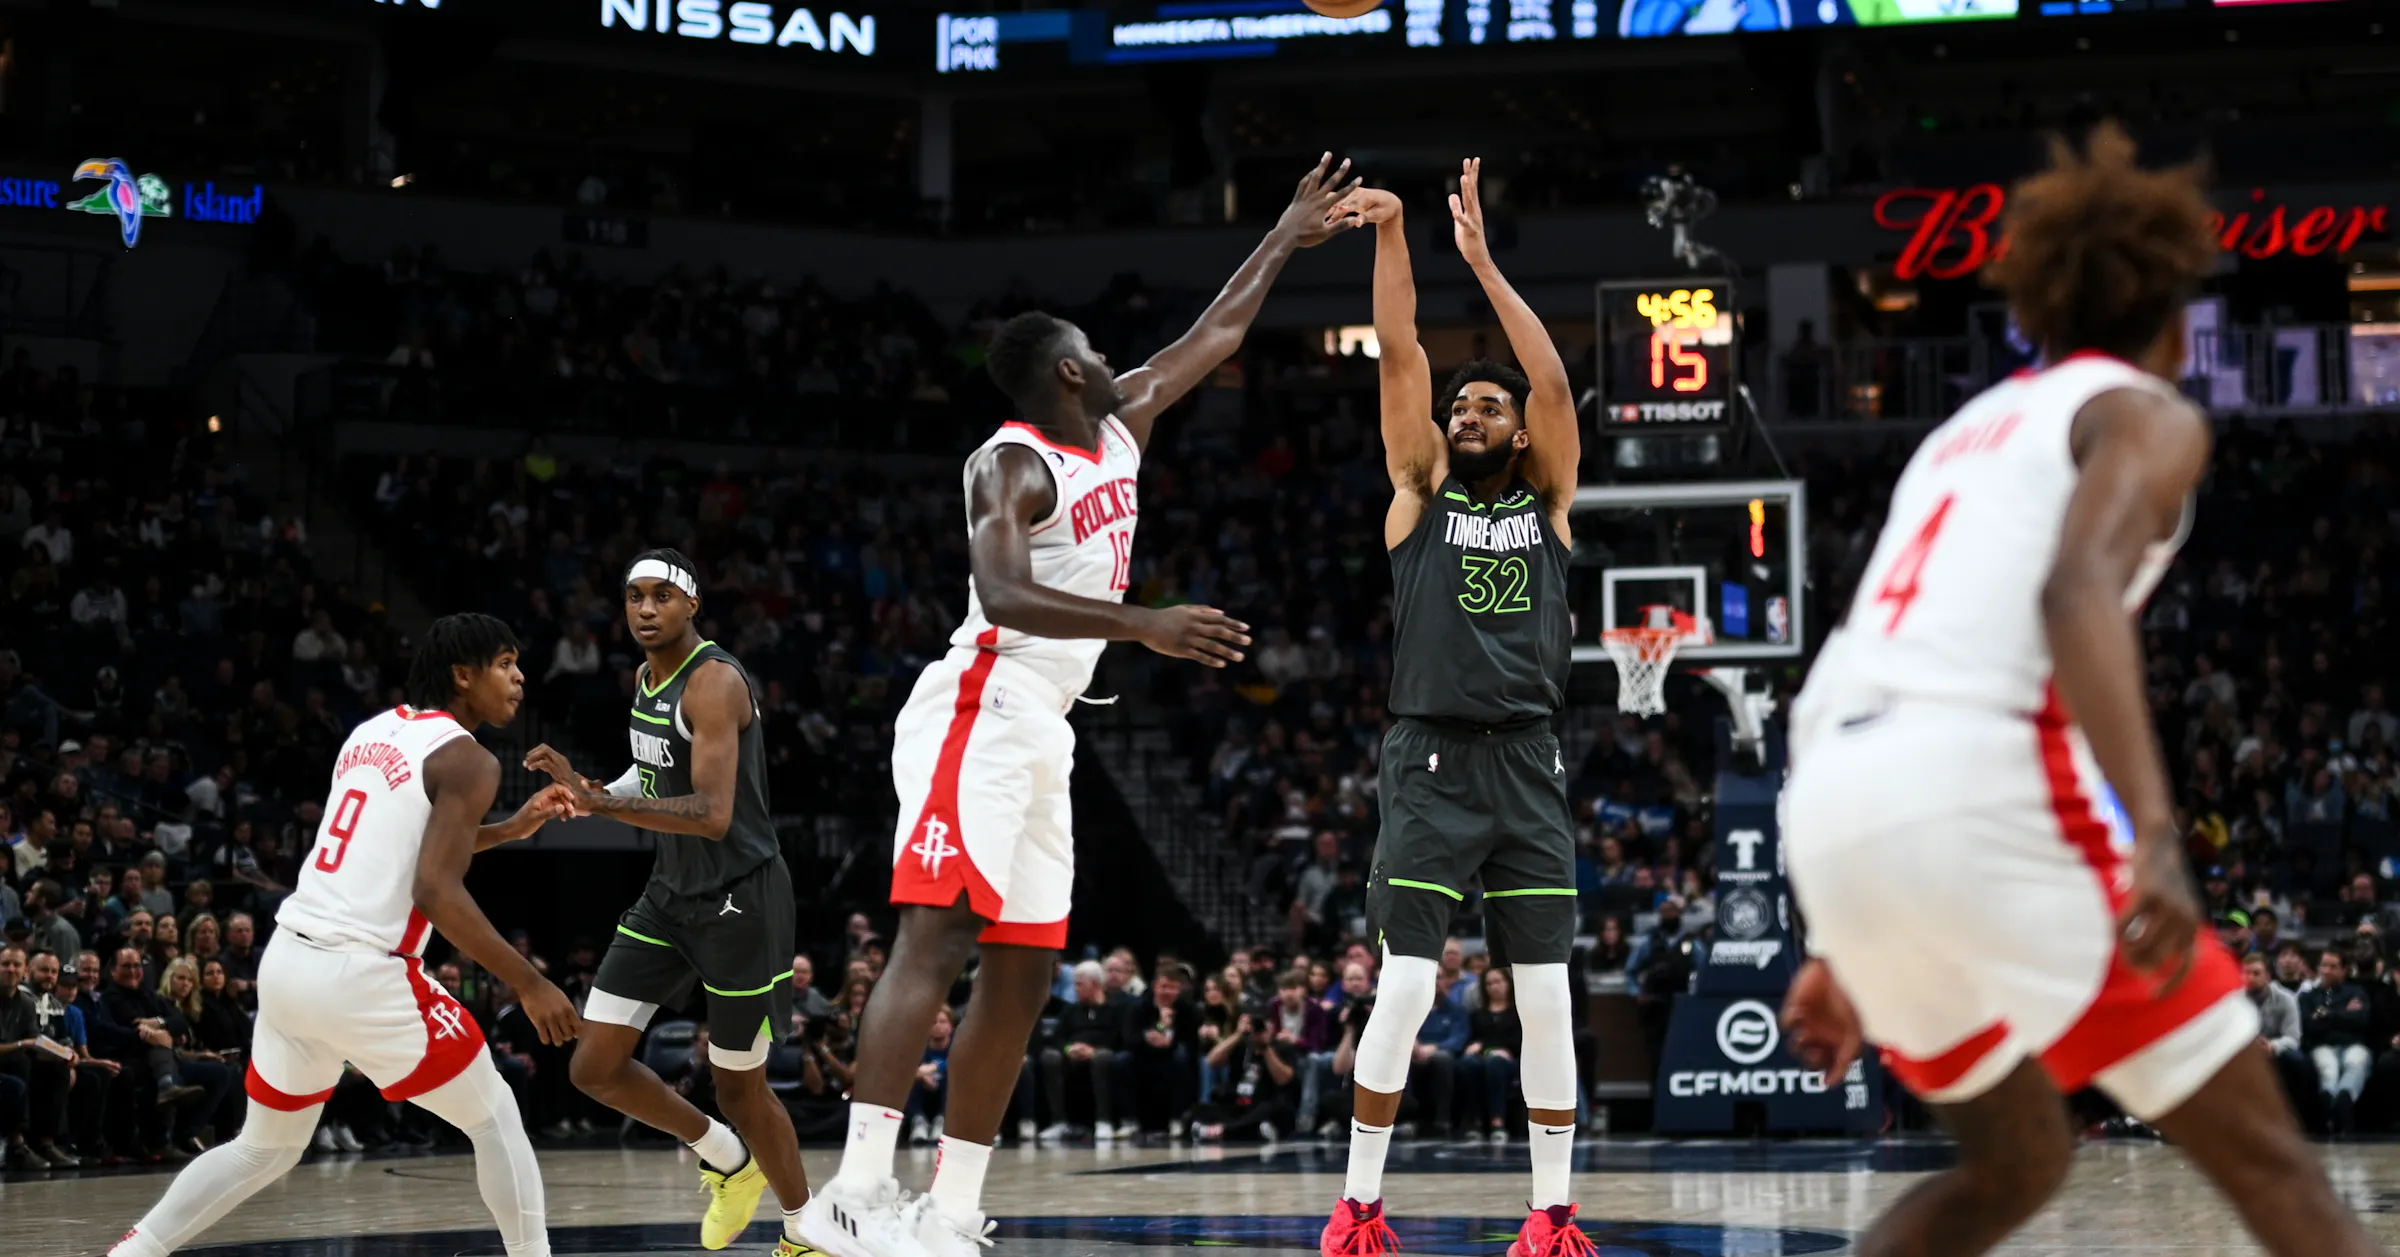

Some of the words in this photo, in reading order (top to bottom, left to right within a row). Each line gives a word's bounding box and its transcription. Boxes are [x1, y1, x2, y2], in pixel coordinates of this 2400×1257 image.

[601, 0, 876, 56] NISSAN
[183, 178, 264, 224] Island
[1636, 288, 1718, 330] 4:56
[1651, 332, 1709, 392] 15
[1640, 401, 1725, 423] TISSOT
[1444, 511, 1543, 553] TIMBERWOLVE
[1457, 555, 1532, 614] 32
[1872, 489, 1958, 641] 4
[335, 742, 412, 792] CHRISTOPHER
[315, 788, 368, 875] 9
[1669, 1068, 1830, 1098] CFMOTO
